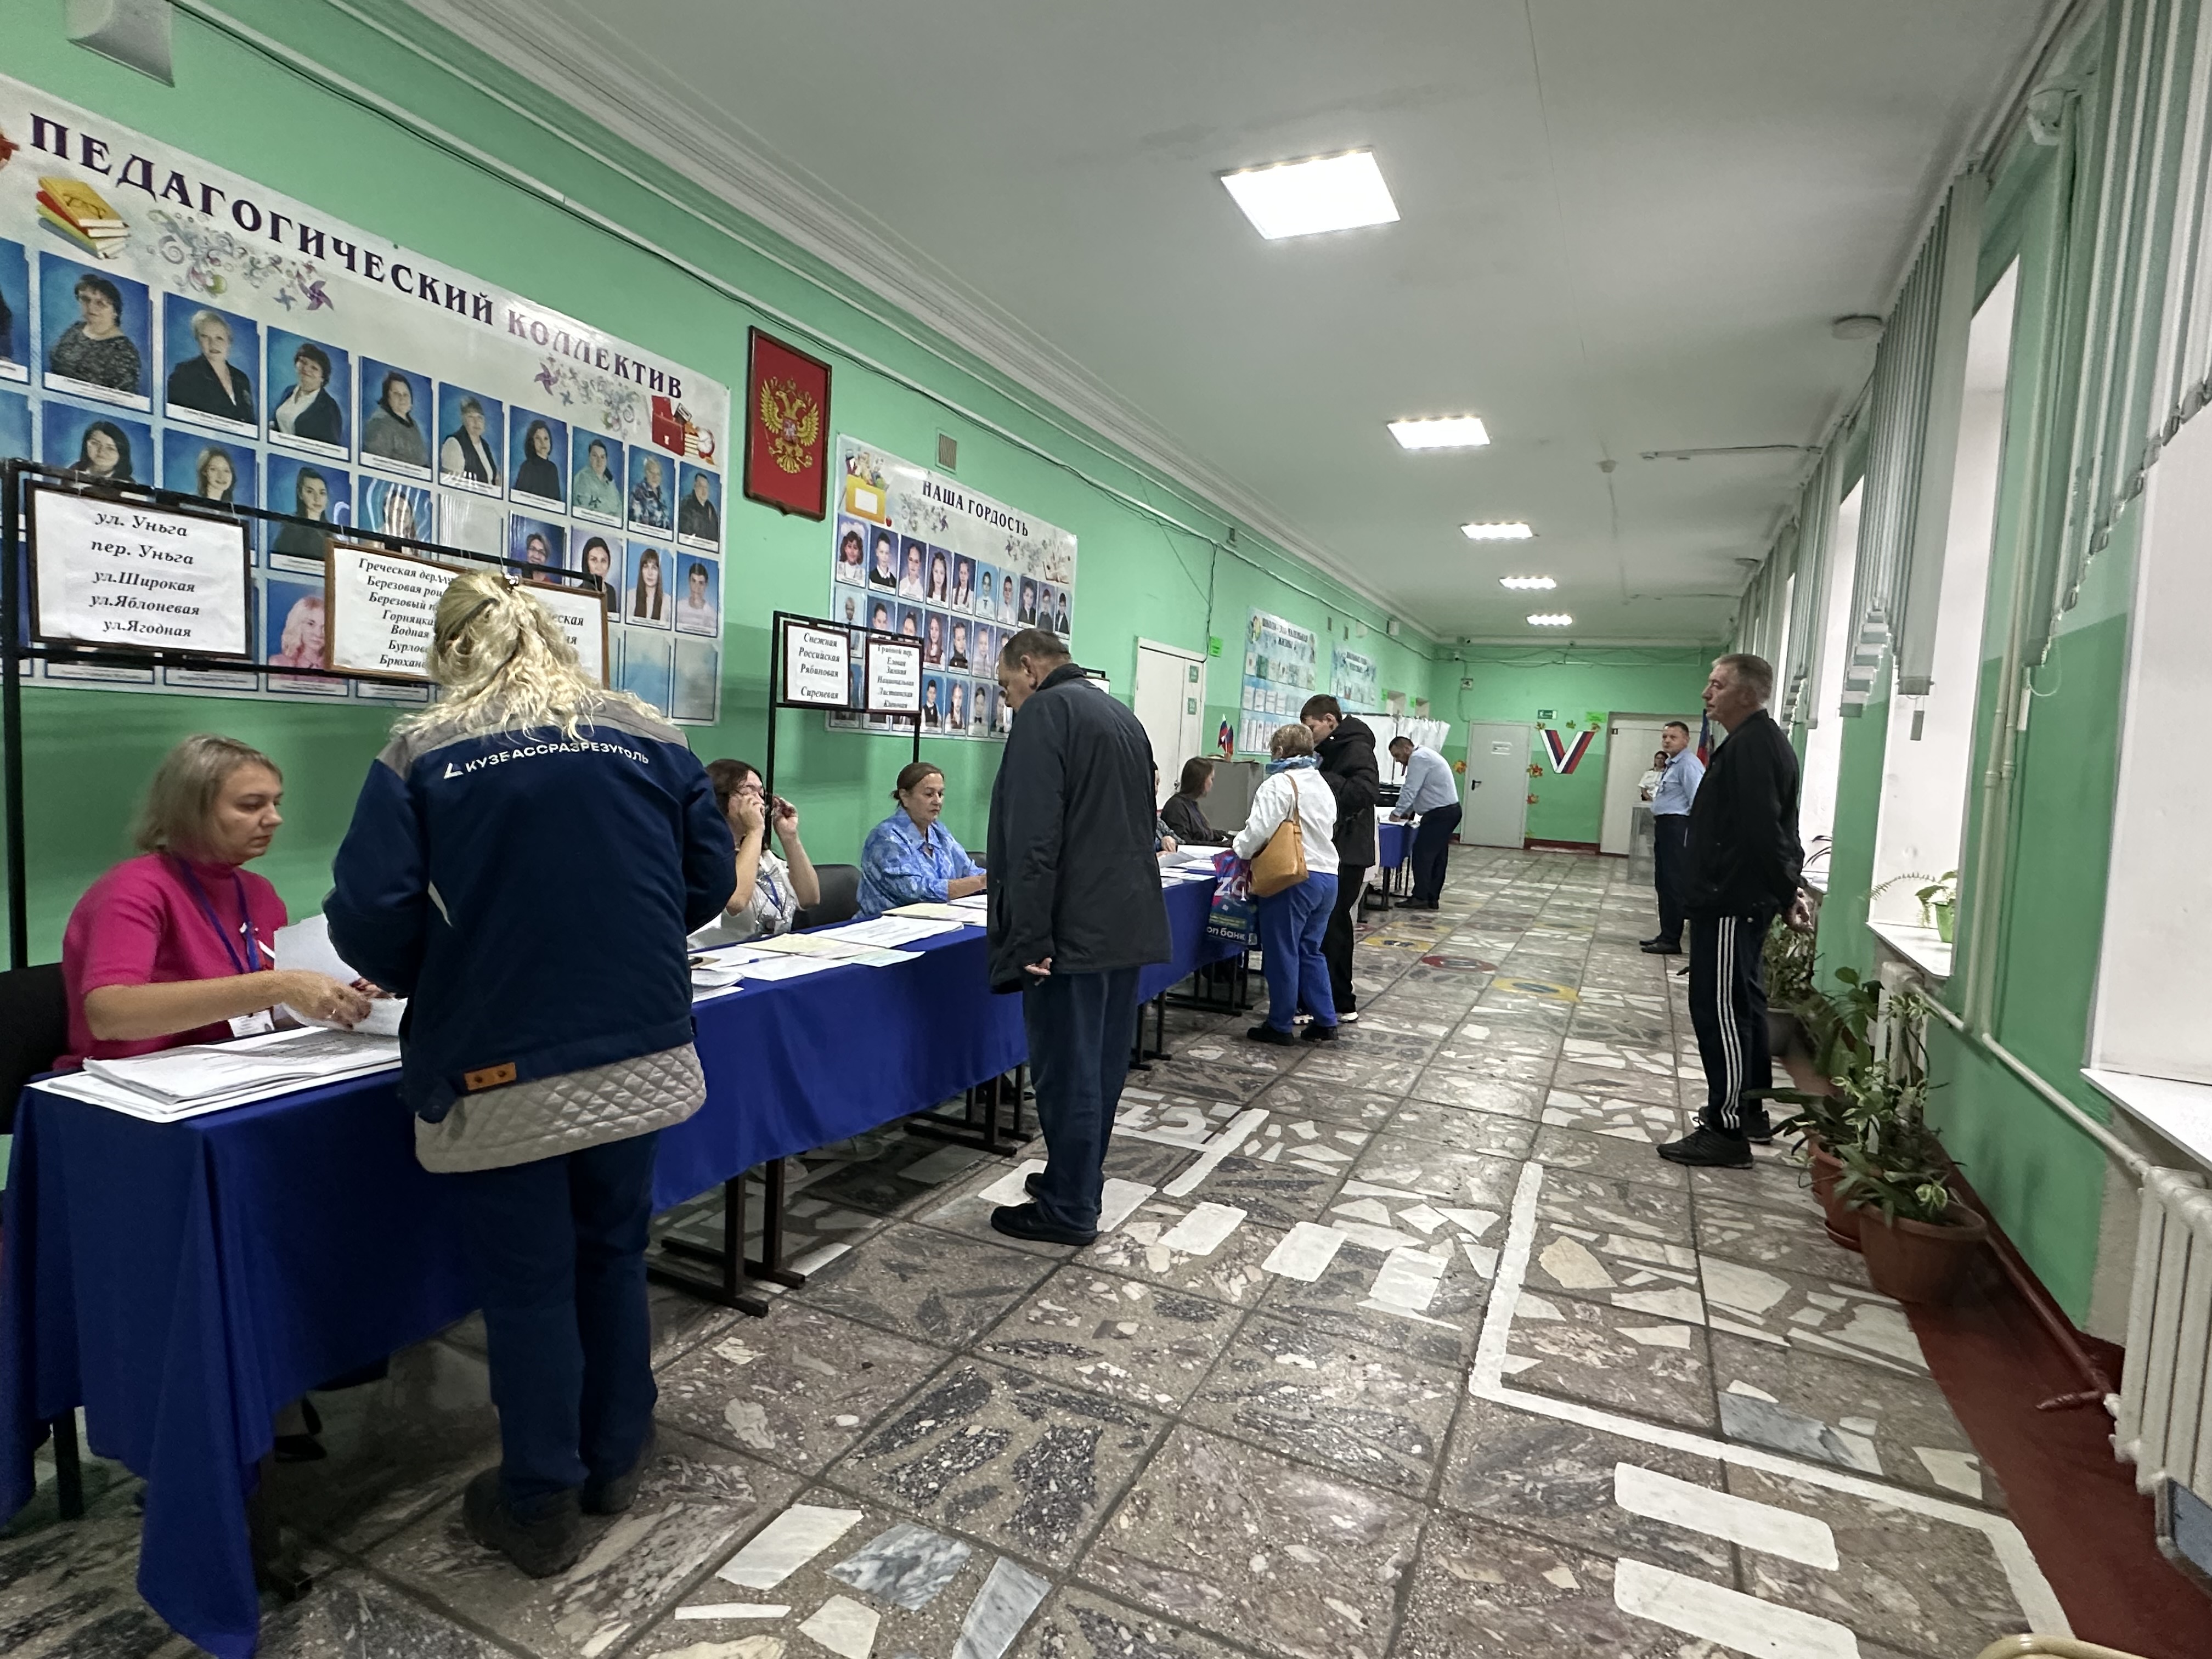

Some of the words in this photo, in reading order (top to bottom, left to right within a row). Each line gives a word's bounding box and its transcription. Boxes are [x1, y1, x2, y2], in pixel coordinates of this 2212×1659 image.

[30, 113, 493, 326] ПЕДАГОГИЧЕСКИЙ
[508, 309, 681, 398] КОЛЛЕКТИВ
[922, 481, 964, 511] НАША
[968, 499, 1028, 537] ГОРДОСТЬ
[95, 512, 125, 526] ул.
[132, 515, 188, 537] Уньга
[91, 540, 131, 558] пер.
[138, 544, 194, 565] Уньга
[359, 557, 416, 577] Греческая
[92, 571, 196, 592] ул.Широкая
[367, 575, 421, 594] Березовая
[88, 593, 200, 616] ул.Яблоневая
[369, 591, 426, 610] Березовый
[382, 610, 434, 626] Горняцка
[103, 619, 192, 637] ул.Ягодная
[391, 624, 429, 639] Водная
[804, 632, 837, 647] Снежная
[799, 647, 840, 663] Российская
[800, 663, 838, 678] Рябиновая
[801, 686, 839, 699] Сиреневая
[465, 742, 649, 772] КУЗБАССРАЗРЕЗУГОЛЬ
[1220, 927, 1245, 940] банк
